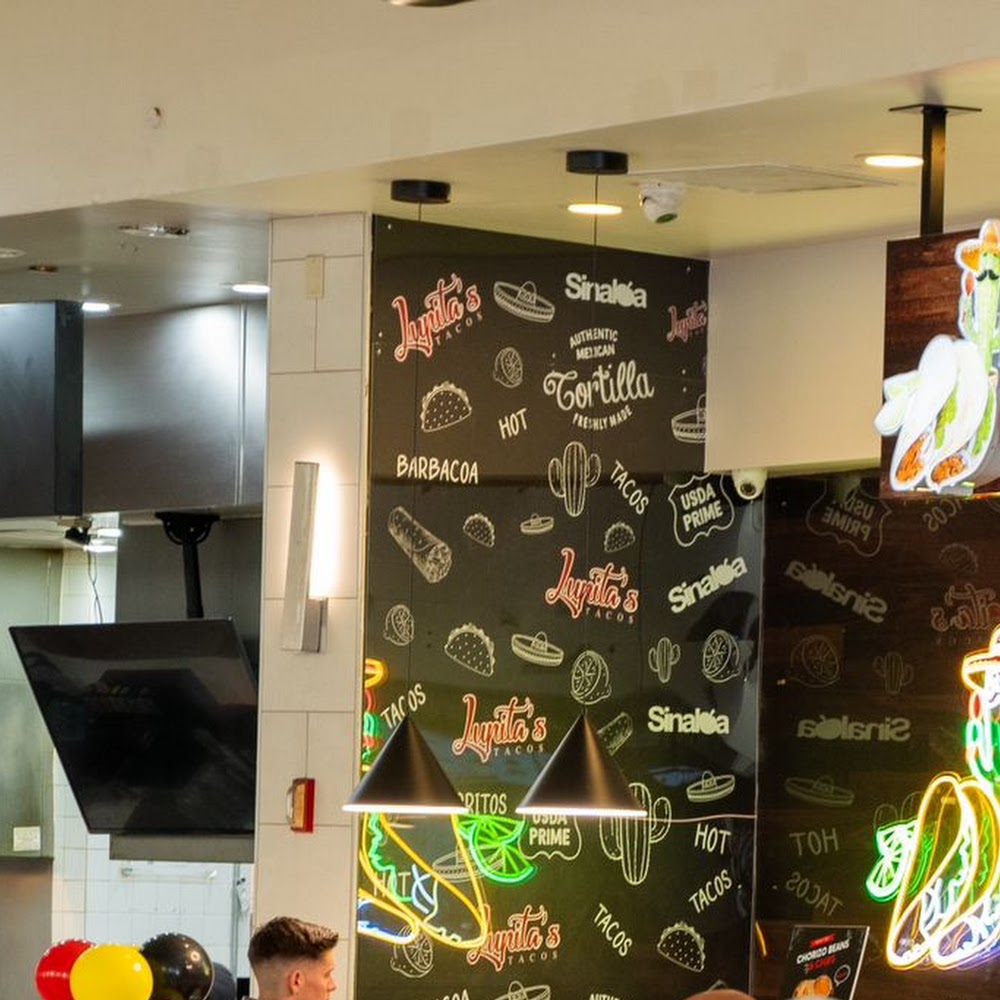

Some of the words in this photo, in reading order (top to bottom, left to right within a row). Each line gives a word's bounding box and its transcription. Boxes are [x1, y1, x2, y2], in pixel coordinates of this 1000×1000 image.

[564, 272, 647, 309] Sinaloa
[391, 272, 482, 363] Lupita's
[434, 311, 484, 347] TACOS
[569, 328, 619, 349] AUTHENTIC
[543, 360, 655, 411] Tortilla
[498, 407, 528, 440] HOT
[572, 413, 607, 431] FRESHLY
[609, 404, 633, 427] MADE
[396, 453, 479, 485] BARBACOA
[609, 460, 650, 516] TACOS
[679, 485, 717, 511] USDA
[682, 500, 724, 532] PRIME
[545, 547, 640, 619] Lupita's
[667, 555, 749, 614] Sinaloa
[380, 683, 426, 729] TACOS
[647, 704, 730, 736] Sinaloa
[452, 693, 547, 763] Lupita's
[493, 741, 546, 758] TACOS
[529, 827, 571, 847] PRIME
[694, 824, 731, 855] HOT
[688, 869, 732, 914] TACOS
[594, 903, 634, 958] TACOS
